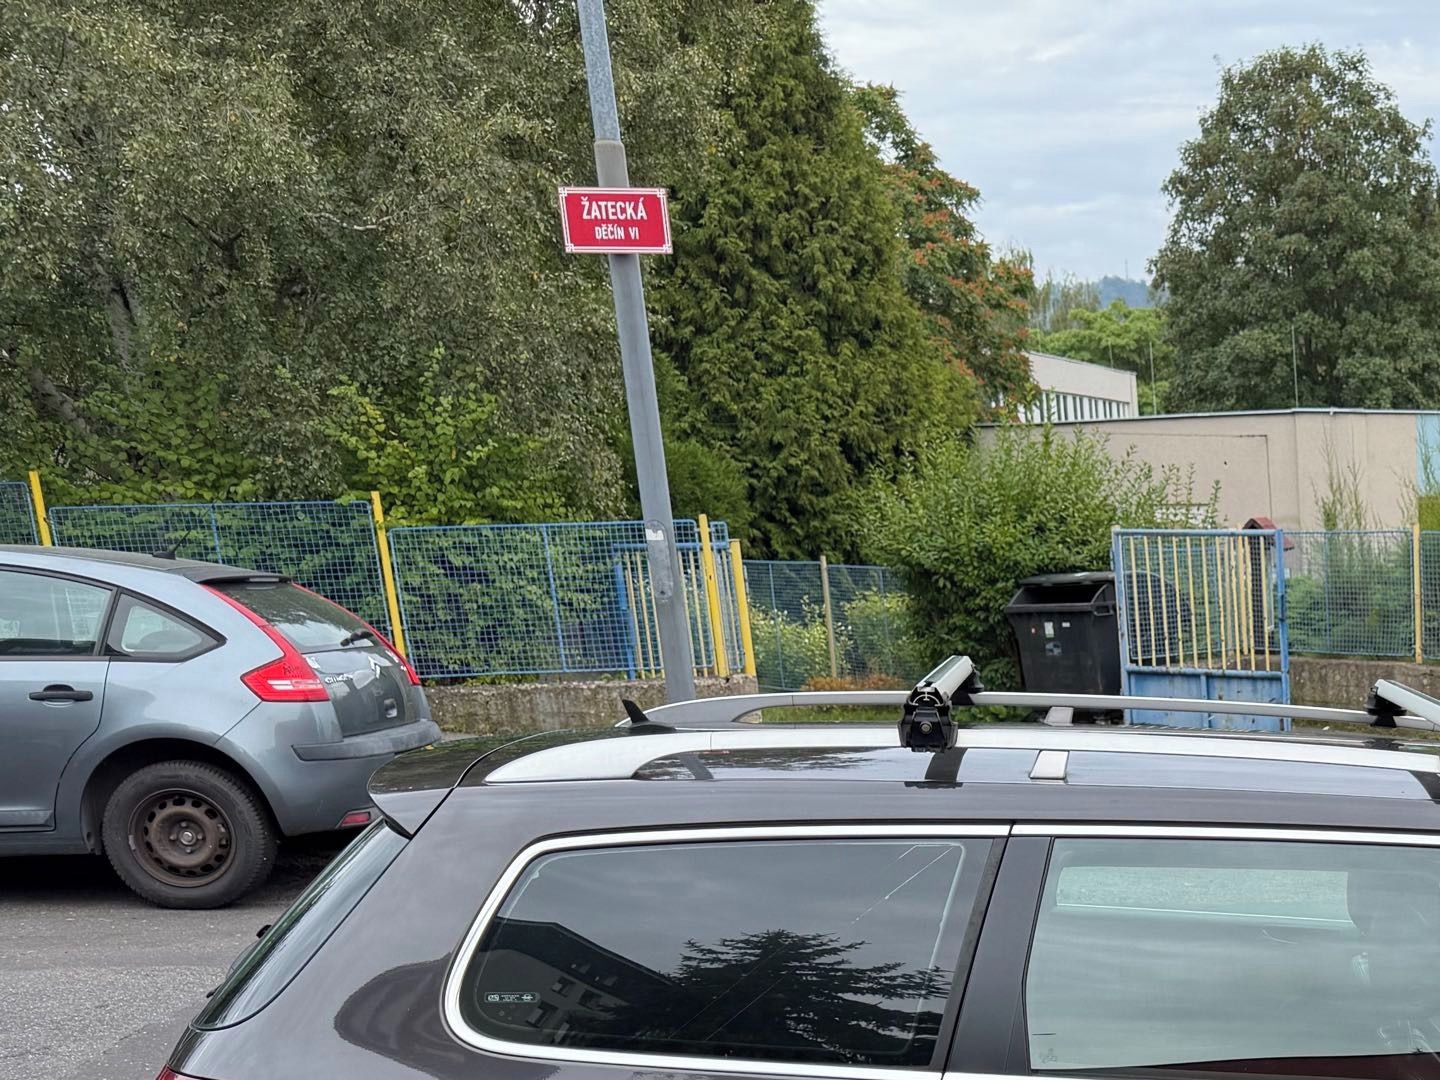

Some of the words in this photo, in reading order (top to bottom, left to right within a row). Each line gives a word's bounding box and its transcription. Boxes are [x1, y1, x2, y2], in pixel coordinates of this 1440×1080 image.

[581, 196, 647, 220] ŽATECKÁ
[595, 223, 625, 239] DĚČÍN
[629, 226, 640, 240] VI
